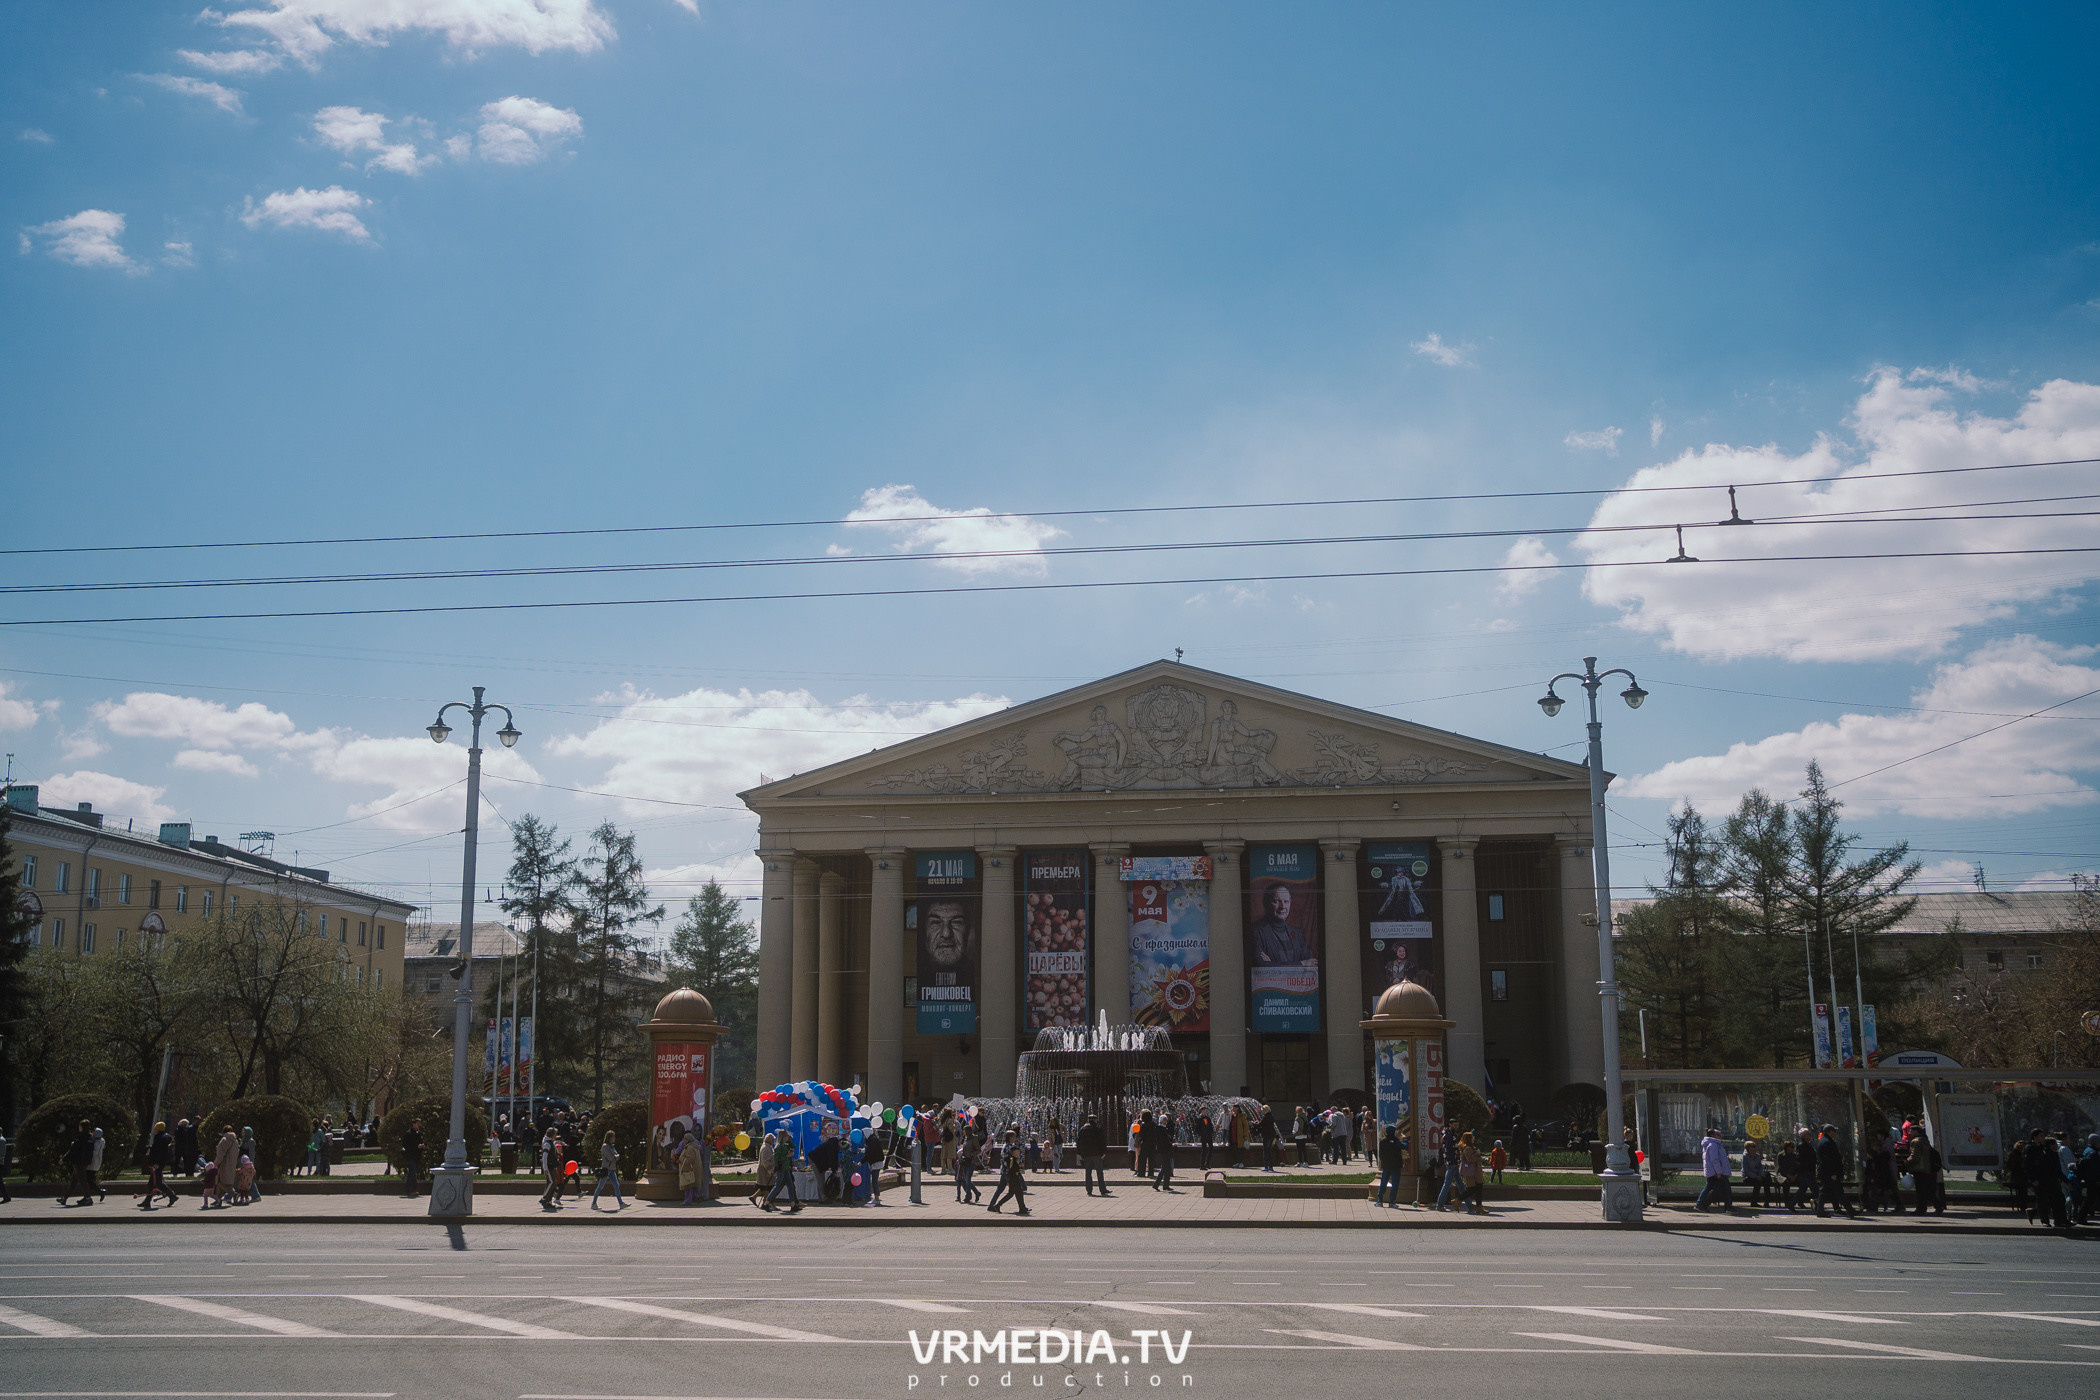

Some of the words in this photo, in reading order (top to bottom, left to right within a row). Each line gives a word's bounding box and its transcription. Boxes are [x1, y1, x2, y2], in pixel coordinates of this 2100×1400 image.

[1124, 858, 1131, 866] 9
[1268, 853, 1275, 866] 6
[1276, 853, 1298, 865] МАЯ
[928, 859, 943, 877] 21
[945, 859, 963, 877] МАЯ
[1032, 866, 1081, 879] ПРЕМЬЕРА
[1141, 885, 1158, 905] 9
[1138, 907, 1163, 916] мая
[1132, 937, 1141, 949] С
[1030, 953, 1083, 973] ЦАРЁВЫ
[1287, 976, 1316, 987] ПОБЕДА
[921, 986, 972, 1002] ГРИШКОВЕЦ
[1263, 998, 1289, 1007] ДАНИИЛ
[921, 1004, 972, 1013] МОНОЛОГ-КОНЦЕРТ
[1259, 1005, 1313, 1016] СПИВАКОВСКИЙ
[658, 1054, 686, 1063] РАДИО
